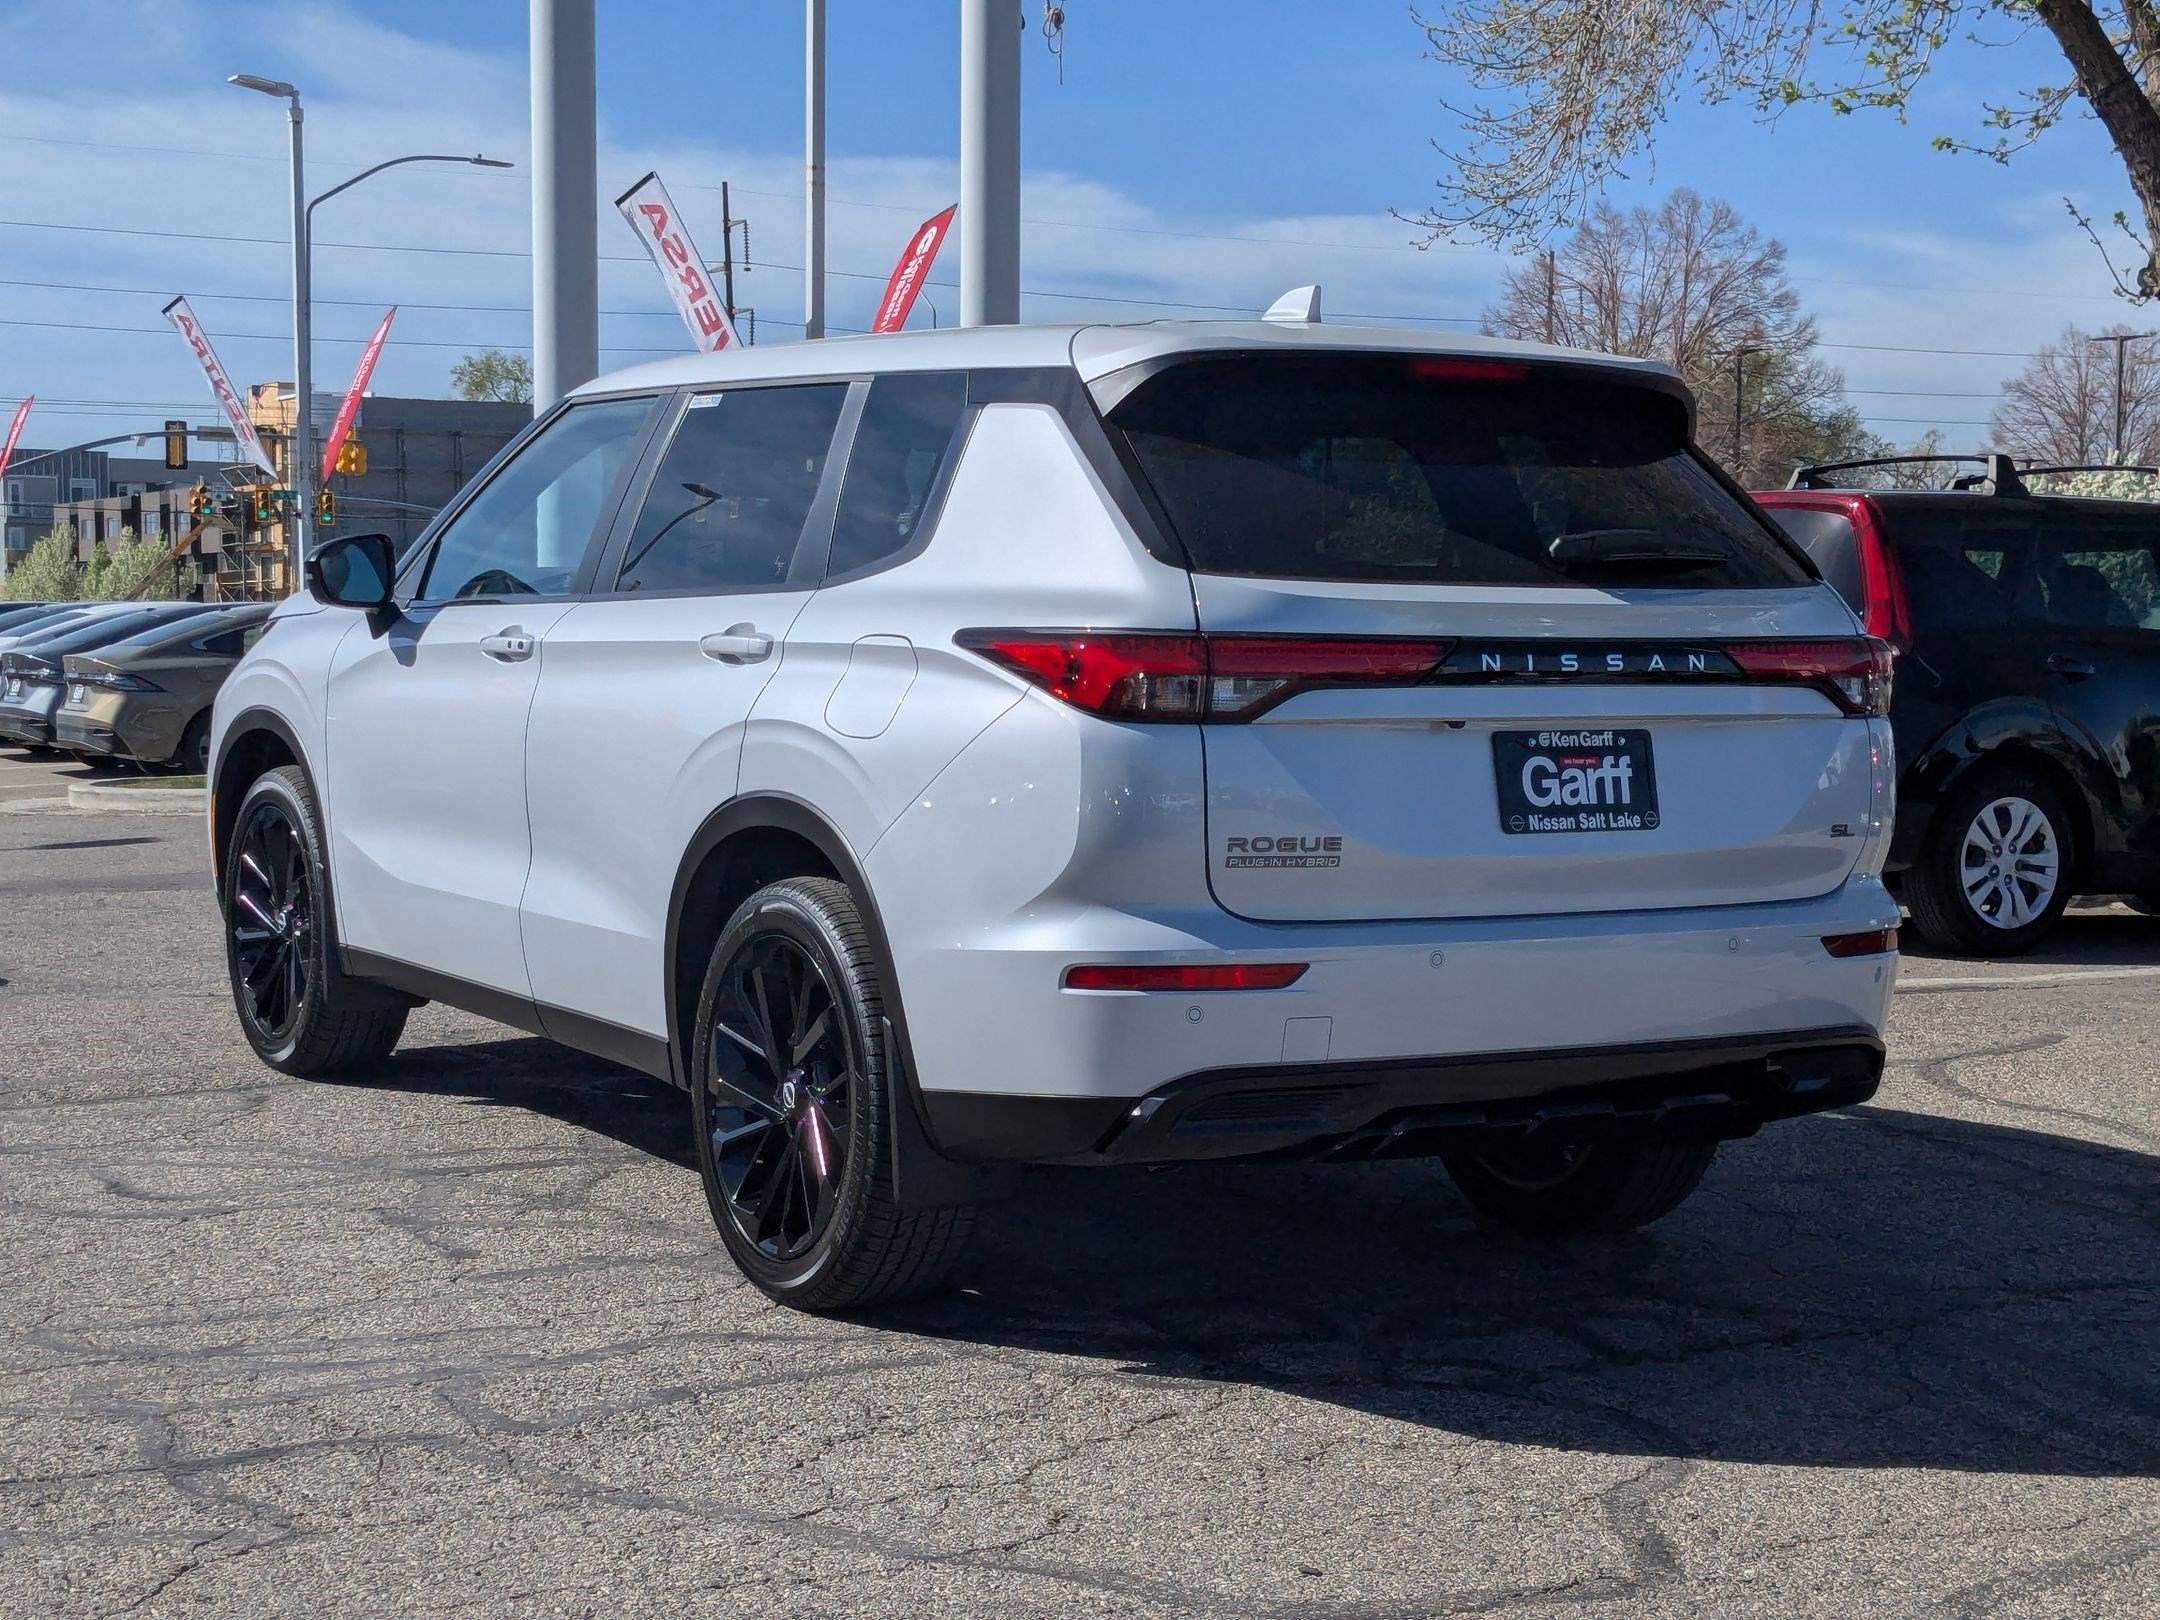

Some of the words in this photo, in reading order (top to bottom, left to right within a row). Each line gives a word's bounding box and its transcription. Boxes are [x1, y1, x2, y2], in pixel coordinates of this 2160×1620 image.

[1480, 653, 1706, 673] NISSAN
[1551, 731, 1579, 747] Ken
[1580, 731, 1613, 747] Garff
[1521, 755, 1633, 808] Garff
[1528, 814, 1576, 831] Nissan
[1578, 812, 1607, 830] Salt
[1608, 811, 1642, 828] Lake
[1830, 823, 1855, 838] SL
[1227, 836, 1343, 853] ROGUE
[1228, 858, 1283, 867] PLUG-IN
[1285, 857, 1339, 867] HYBRID
